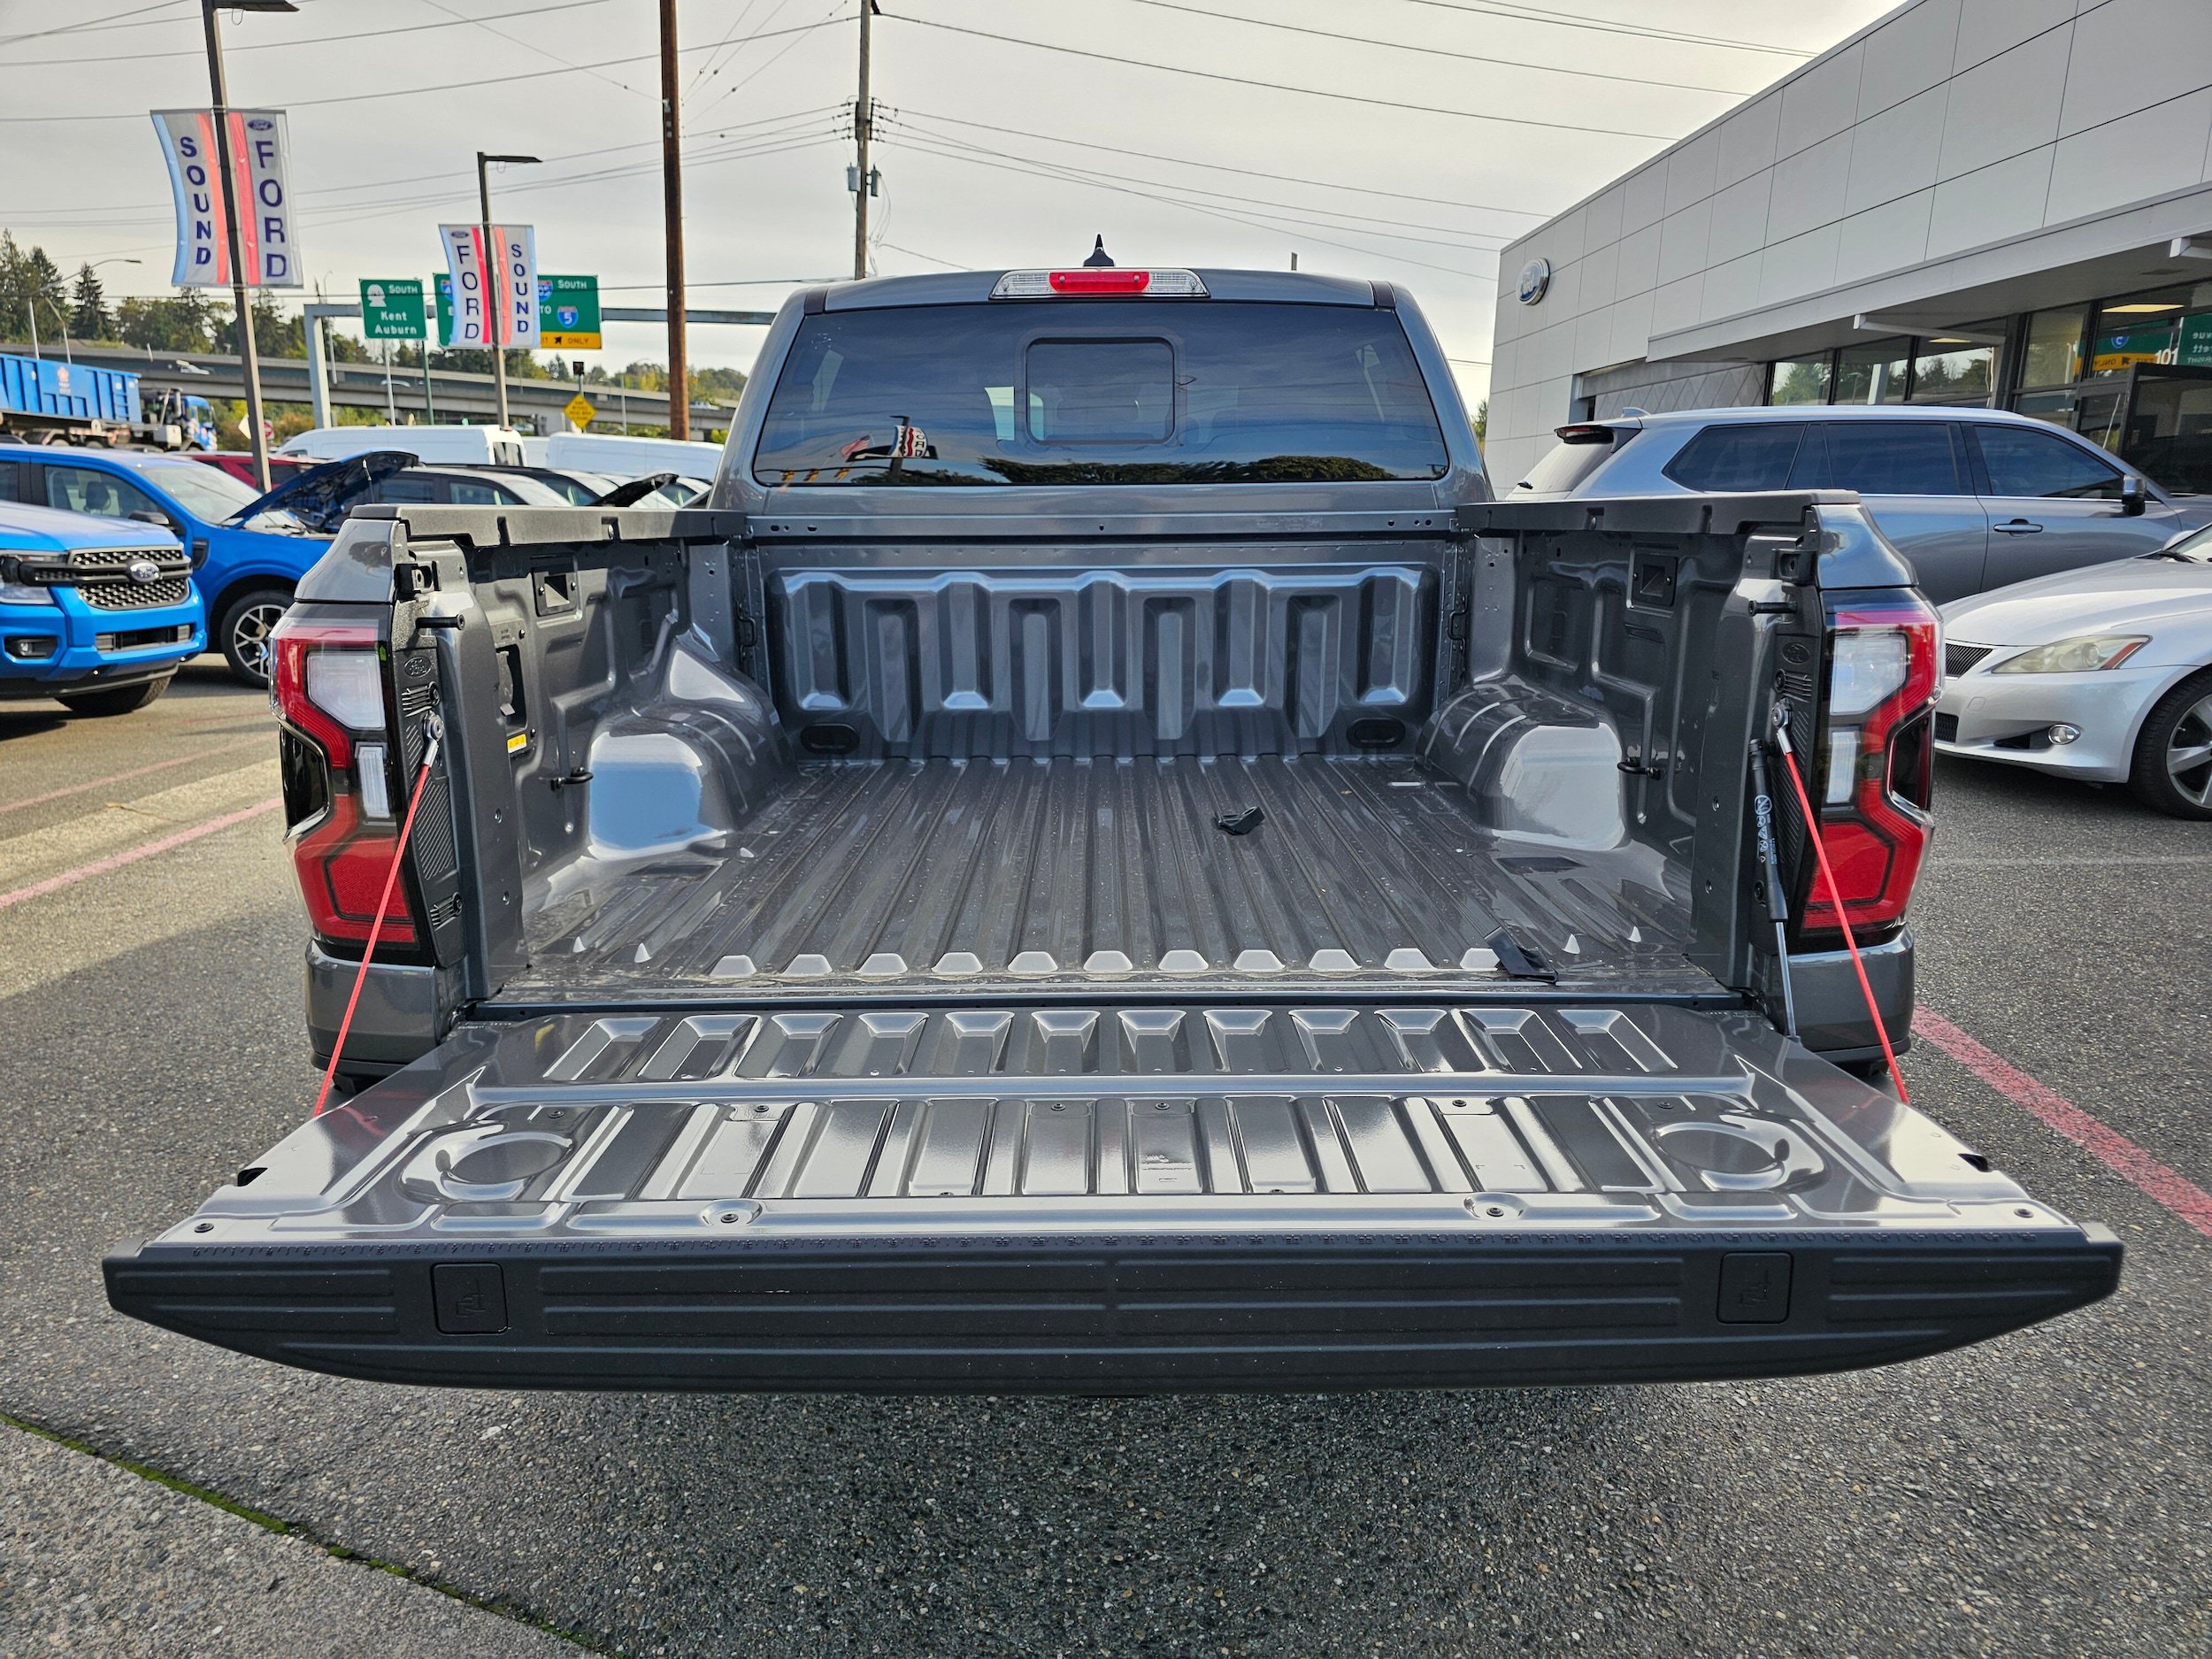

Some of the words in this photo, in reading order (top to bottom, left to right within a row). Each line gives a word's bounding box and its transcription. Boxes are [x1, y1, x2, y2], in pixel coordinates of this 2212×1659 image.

[180, 136, 211, 265] SOUND
[255, 141, 287, 278] FORD
[388, 284, 418, 294] SOUTH
[457, 245, 480, 339] FORD
[511, 243, 529, 333] SOUND
[557, 279, 587, 289] SOUTH
[380, 311, 407, 321] Kent
[564, 311, 572, 325] 5
[374, 324, 417, 334] Auburn
[2154, 347, 2179, 365] 101
